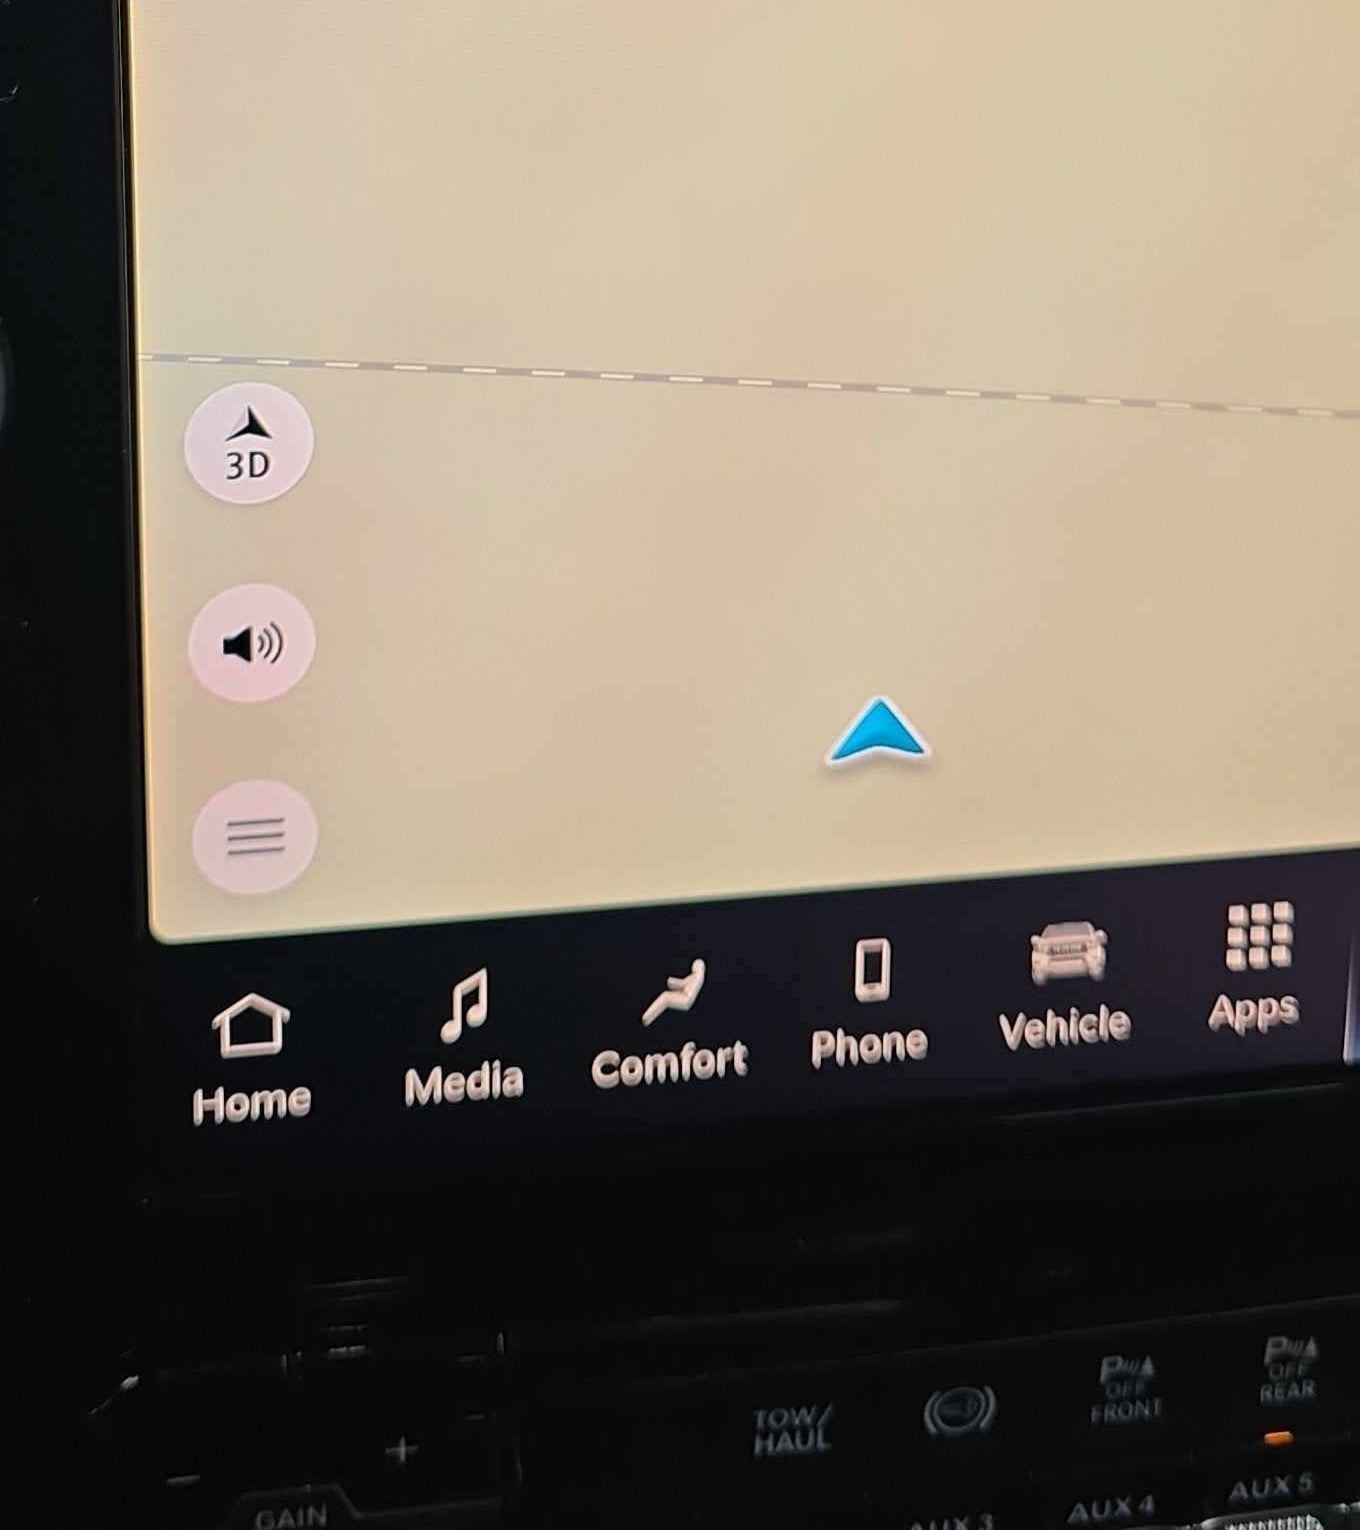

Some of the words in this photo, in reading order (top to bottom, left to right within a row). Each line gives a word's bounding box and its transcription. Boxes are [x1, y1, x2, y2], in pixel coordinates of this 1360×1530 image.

[226, 450, 270, 481] 3D
[998, 1003, 1133, 1052] Vehicle
[1207, 990, 1301, 1036] Apps
[591, 1038, 750, 1090] Comfort
[810, 1025, 929, 1071] Phone
[404, 1058, 525, 1109] Media
[192, 1084, 313, 1128] Home
[1258, 1377, 1318, 1405] REAR
[751, 1401, 835, 1434] TOW/
[1090, 1395, 1163, 1425] FRONT
[752, 1428, 833, 1459] HAUL
[1228, 1474, 1295, 1504] AUX
[1298, 1472, 1316, 1497] 5
[253, 1502, 330, 1530] GAIN
[1066, 1497, 1131, 1526] AUX
[1139, 1493, 1157, 1518] 4
